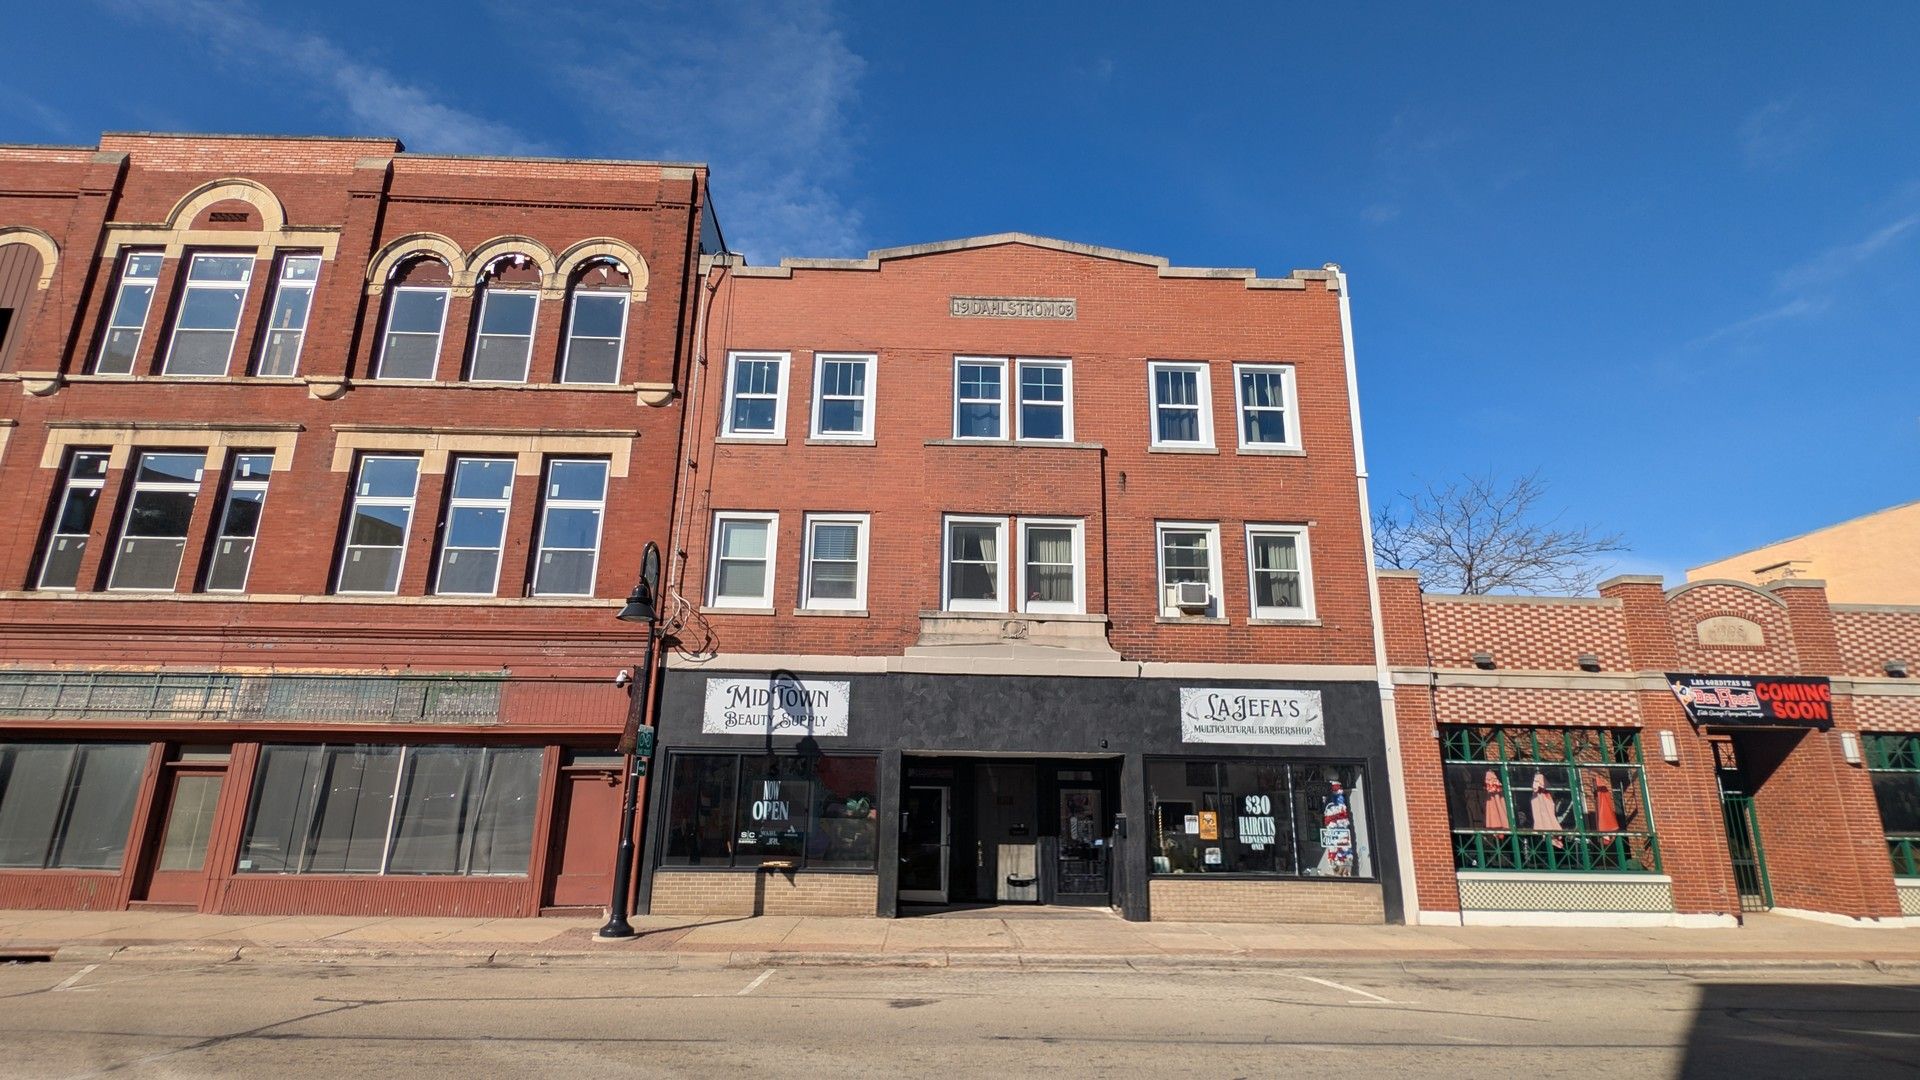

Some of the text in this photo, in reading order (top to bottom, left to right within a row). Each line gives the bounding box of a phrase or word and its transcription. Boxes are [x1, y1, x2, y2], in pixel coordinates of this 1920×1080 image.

[954, 301, 1074, 316] 19 DAHLSTROM 09
[1756, 682, 1831, 701] COMING
[724, 710, 828, 729] BEAUTY SUPPLY
[1772, 701, 1828, 720] SOON
[1194, 725, 1312, 735] MULTICULTURAL BARBERSHOP
[763, 780, 781, 800] NOW
[752, 800, 789, 820] OPEN
[1245, 794, 1271, 815] $30
[1238, 816, 1276, 836] HAIRCUTS
[1239, 835, 1275, 844] WEDNESDAY
